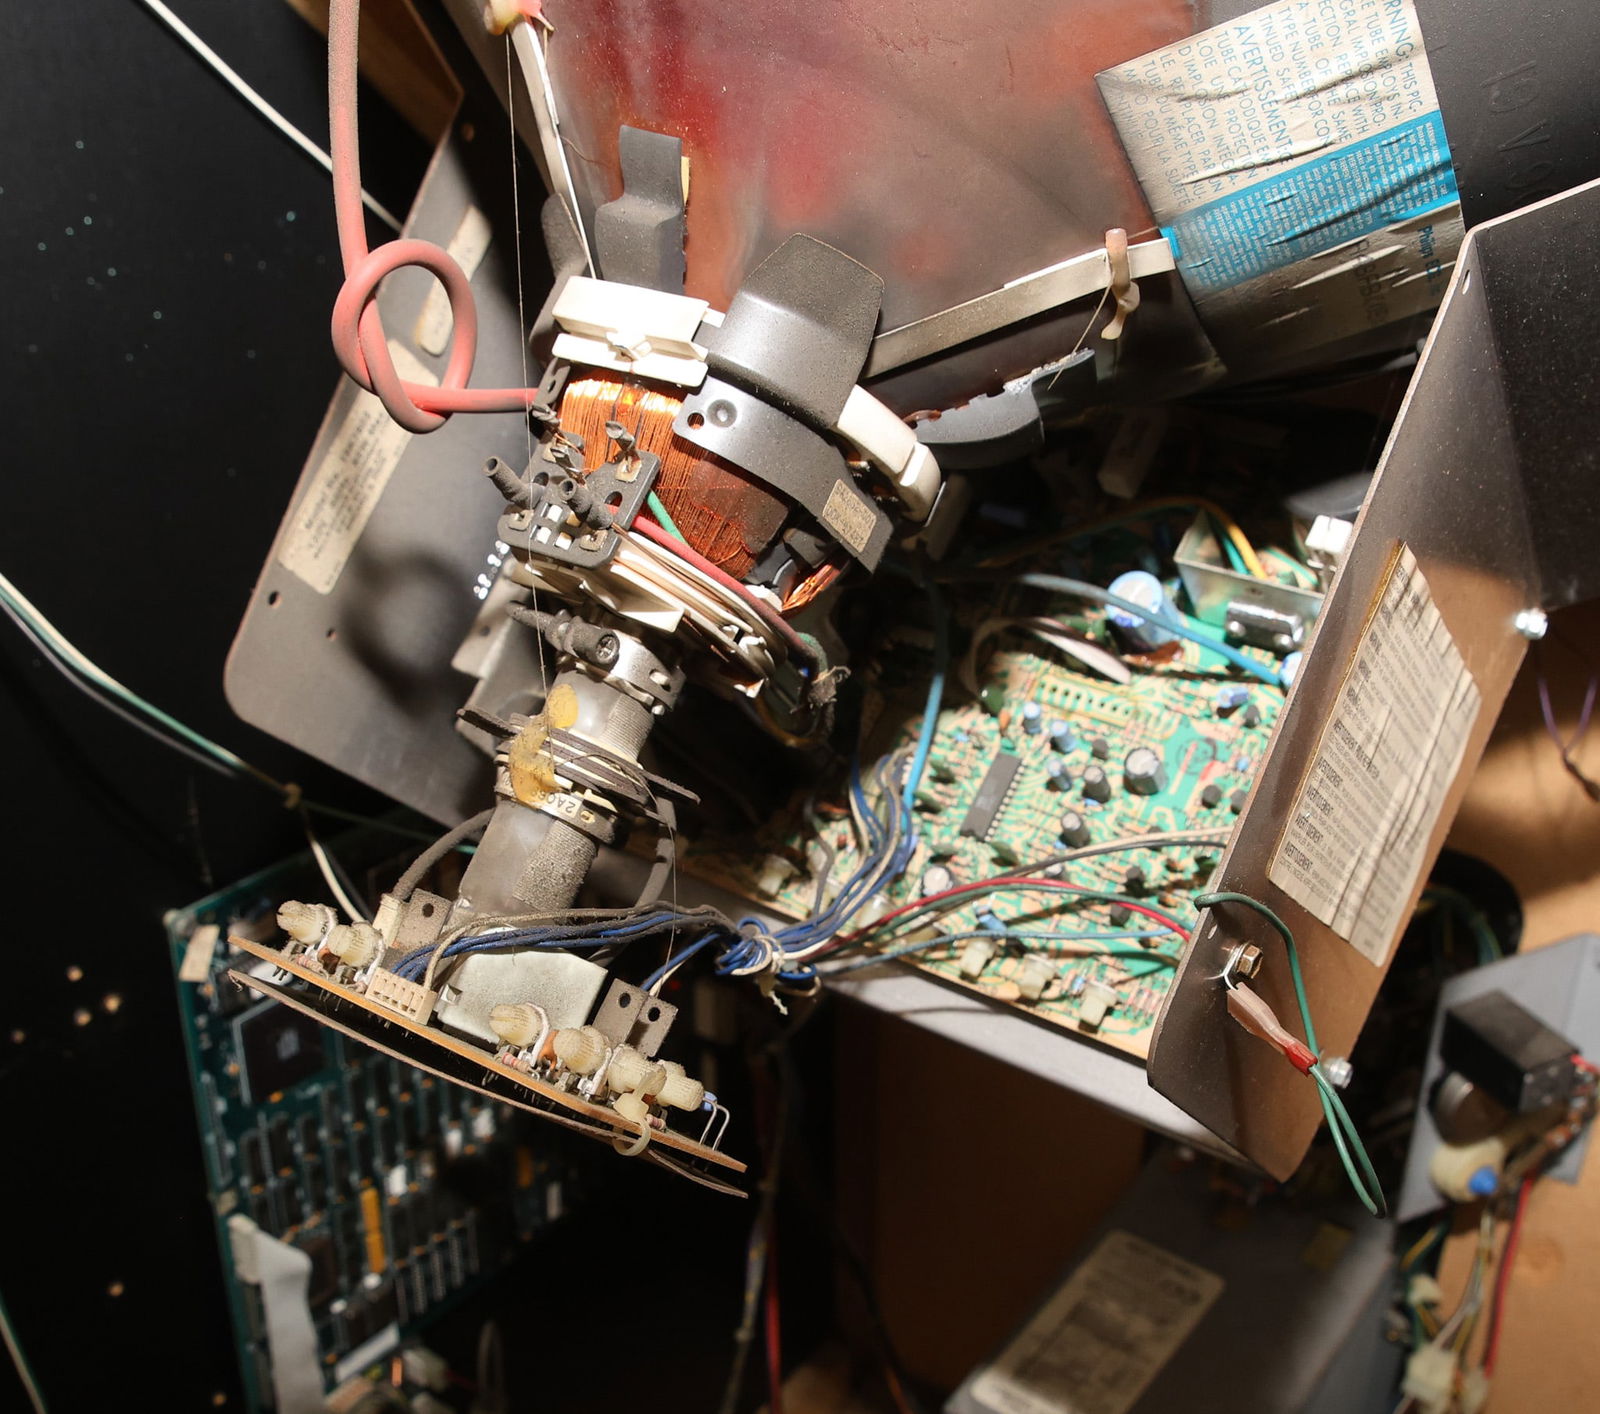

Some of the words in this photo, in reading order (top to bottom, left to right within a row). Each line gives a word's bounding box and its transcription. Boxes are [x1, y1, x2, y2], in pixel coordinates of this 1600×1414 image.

[1295, 0, 1310, 11] A
[1276, 6, 1298, 40] TYPE
[1287, 40, 1315, 93] NUMBER
[1305, 93, 1324, 118] FOR
[1301, 17, 1323, 51] TUBE
[1363, 11, 1385, 45] TUBE
[1374, 48, 1400, 102] EMPLOYS
[1257, 13, 1285, 63] TINUED
[1275, 66, 1302, 114] SAFETY.
[1314, 56, 1332, 77] OF
[1350, 35, 1380, 101] IMPLOSION
[1400, 62, 1417, 90] THIS
[1141, 59, 1164, 93] TUBE
[1177, 149, 1198, 178] TYPE
[1195, 37, 1217, 68] LOIE
[1209, 74, 1230, 102] UNE
[1221, 108, 1258, 179] PROTECTION
[1213, 30, 1237, 64] TUBE
[1226, 64, 1266, 145] CATHODIQUE
[1255, 145, 1276, 173] EM-
[1334, 52, 1360, 104] REPACE
[1350, 104, 1369, 134] WITH
[1140, 109, 1166, 147] POUR
[1156, 148, 1172, 165] LA
[1330, 110, 1352, 143] SAME
[1197, 148, 1215, 171] PAR
[1207, 175, 1223, 193] UN
[1211, 132, 1244, 186] INTÉGA-
[1417, 224, 1434, 260] Philips
